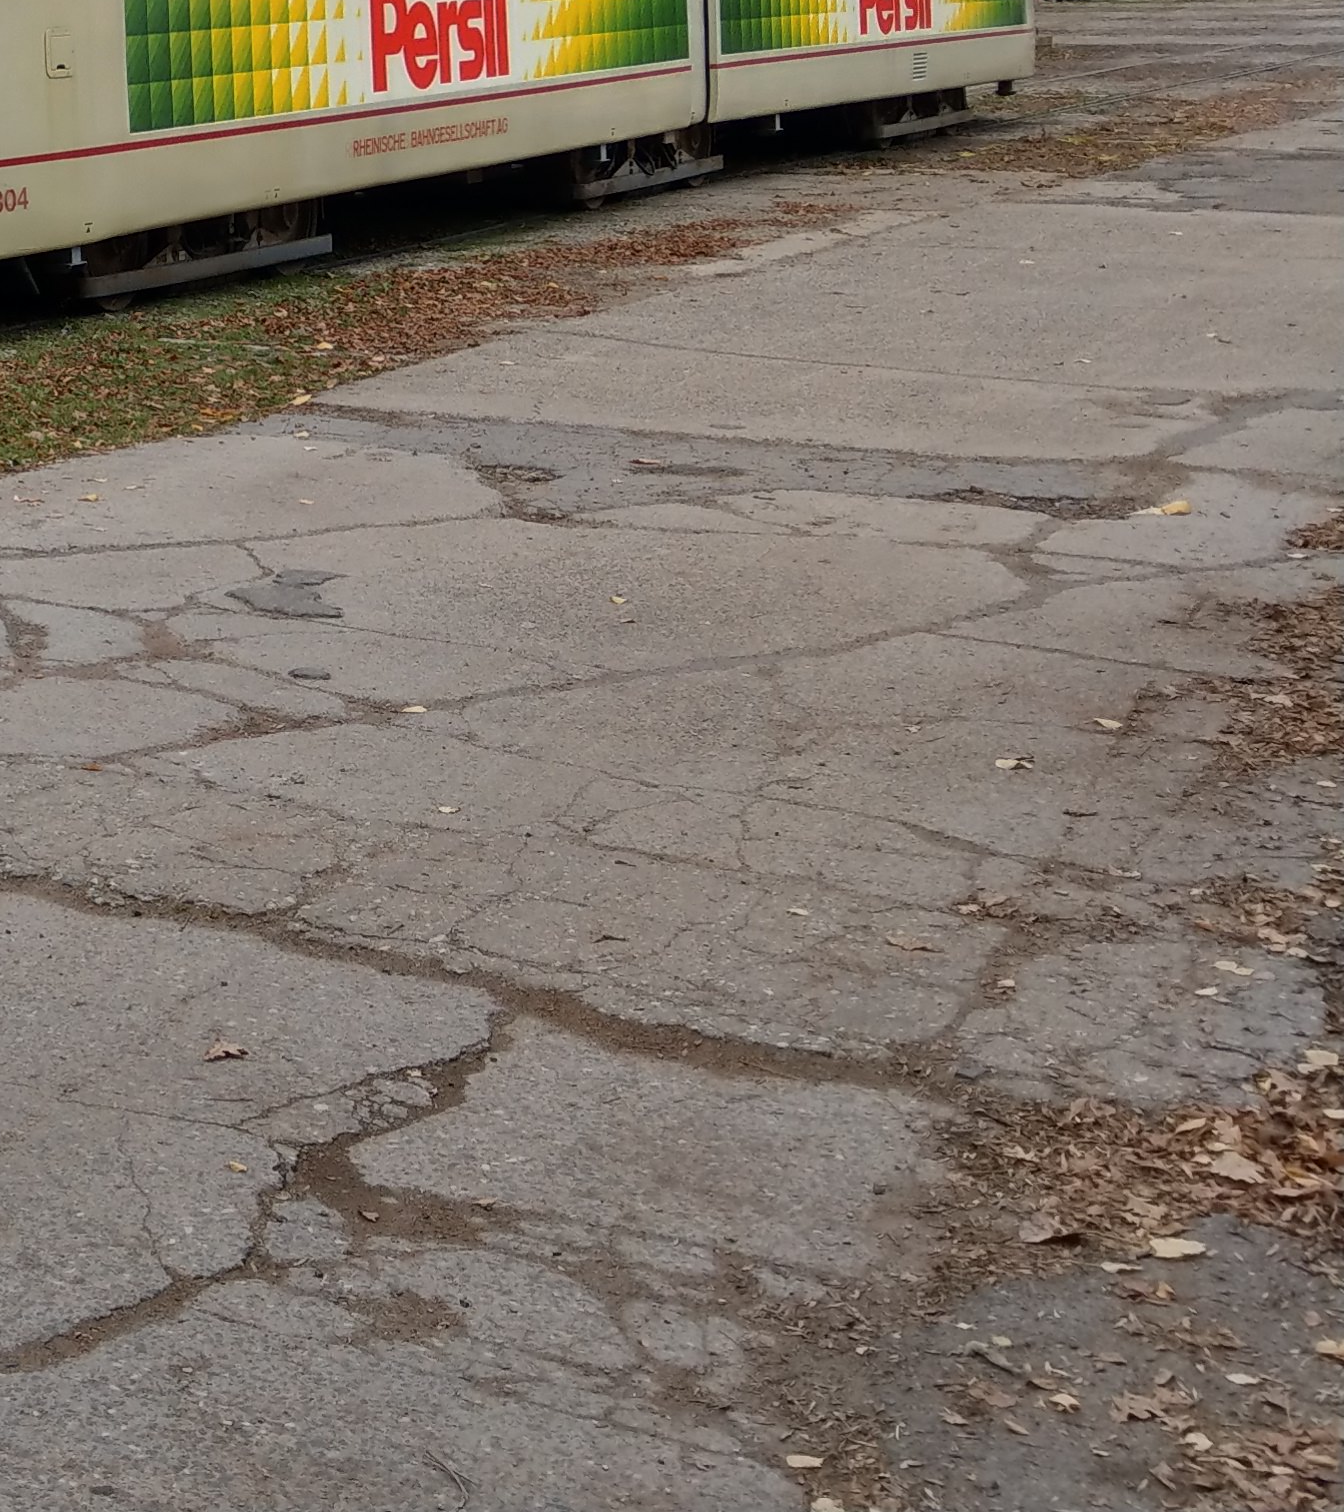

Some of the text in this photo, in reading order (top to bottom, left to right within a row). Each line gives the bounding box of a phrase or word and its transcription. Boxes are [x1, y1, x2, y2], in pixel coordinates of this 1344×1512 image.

[353, 117, 509, 158] RHEINISCHE BAHNGESELLSCHAFT AG
